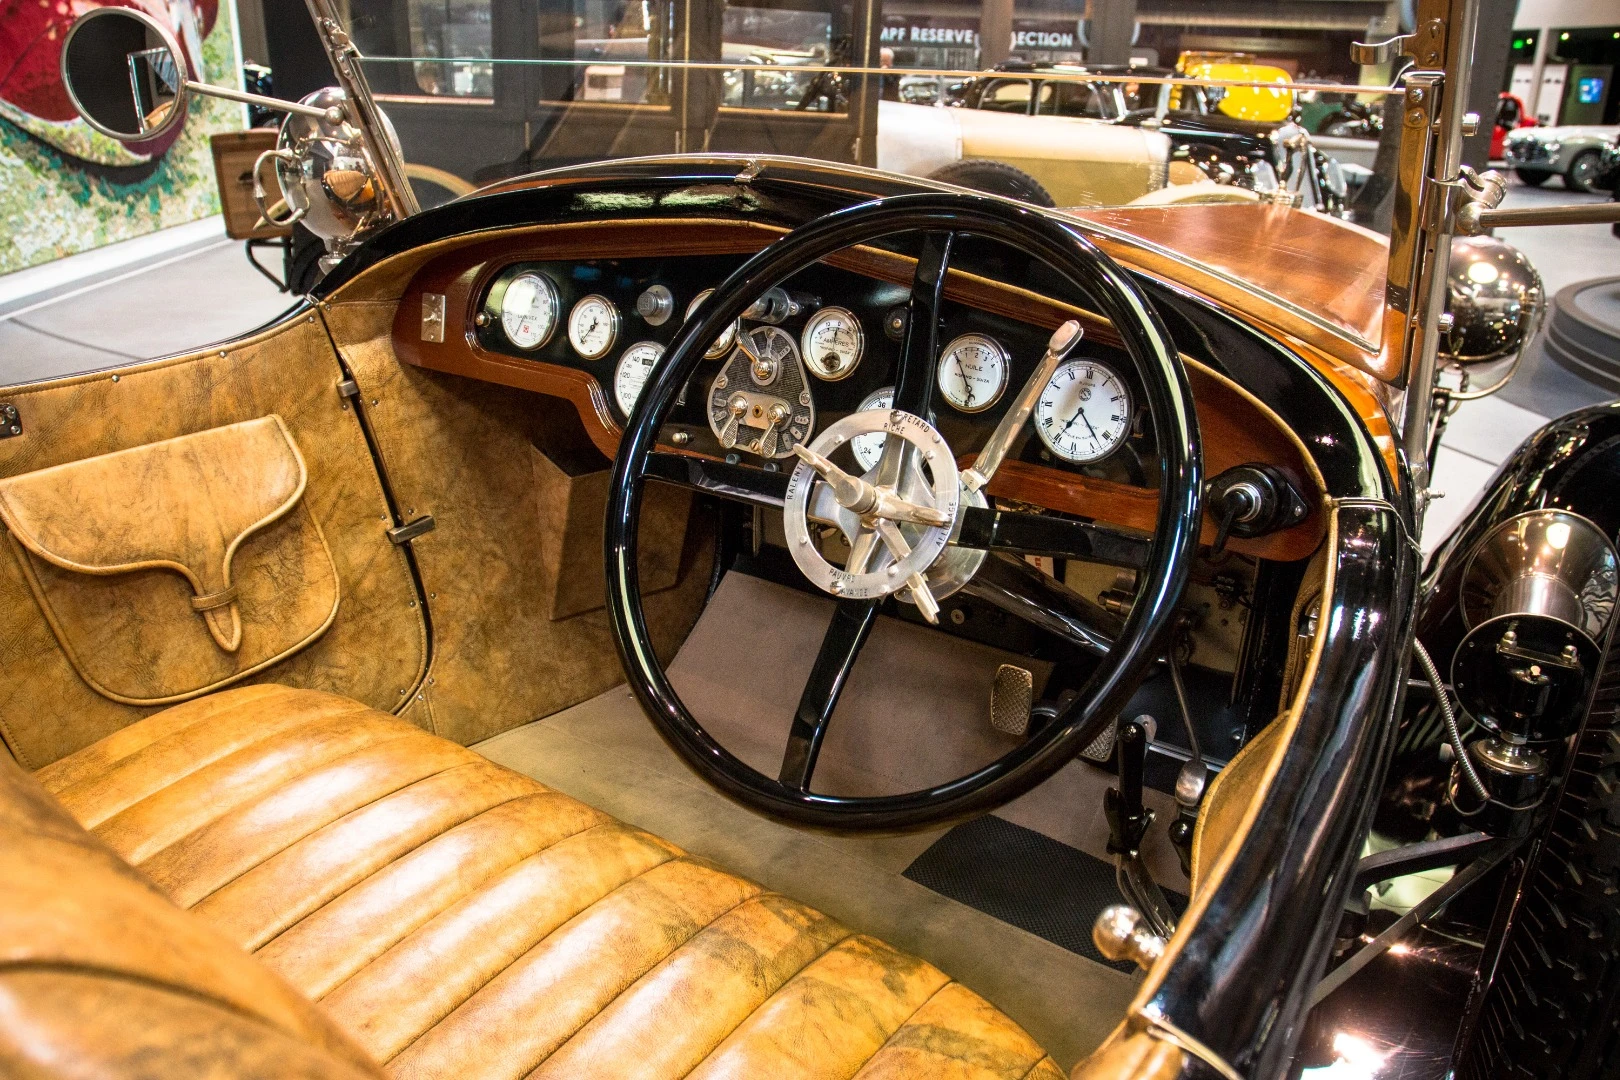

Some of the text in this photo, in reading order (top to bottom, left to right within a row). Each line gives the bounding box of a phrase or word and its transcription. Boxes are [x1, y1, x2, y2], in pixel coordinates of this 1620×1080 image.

[910, 26, 973, 44] RESERVE
[1015, 31, 1073, 47] ECTION
[877, 401, 886, 409] 36
[884, 422, 905, 435] RICHE
[903, 413, 930, 433] RETARD
[863, 447, 872, 455] 24
[786, 462, 805, 500] RALENTI
